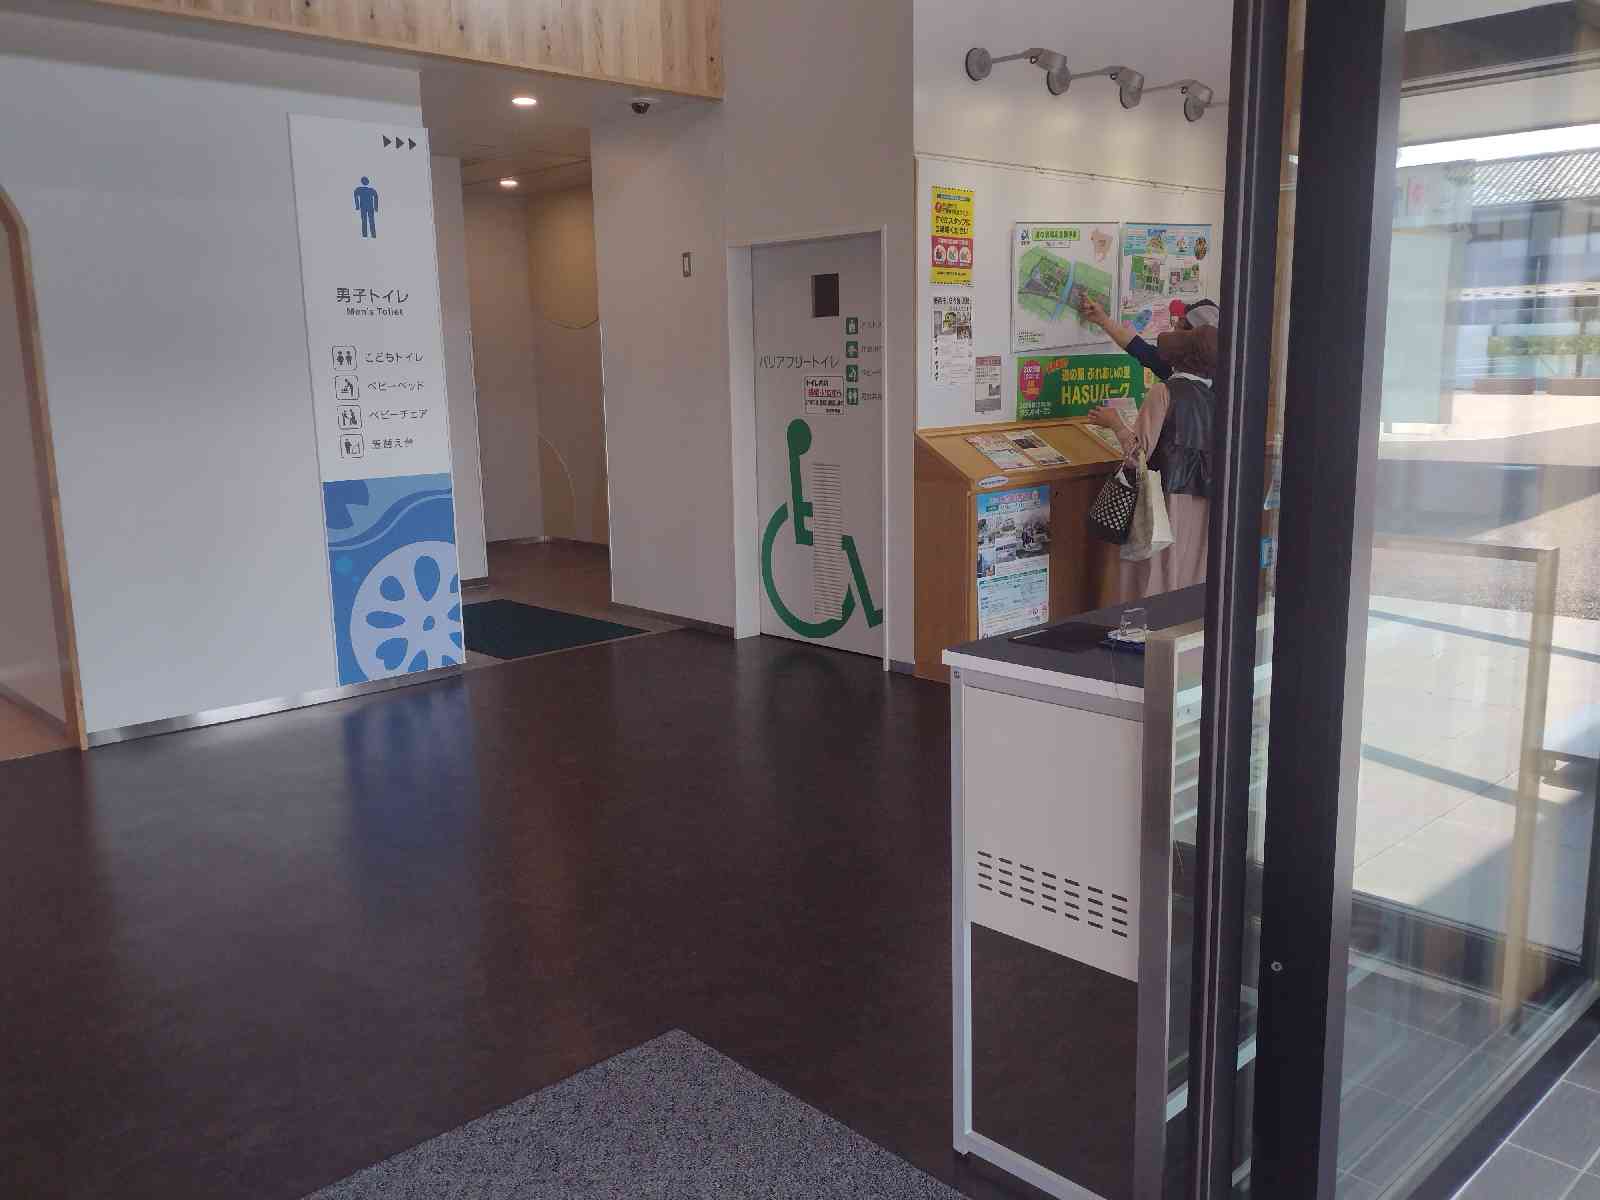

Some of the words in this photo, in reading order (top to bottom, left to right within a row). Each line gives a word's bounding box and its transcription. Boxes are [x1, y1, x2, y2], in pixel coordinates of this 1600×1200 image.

[336, 287, 409, 304] 男子トイレ
[759, 354, 839, 369] バリアフリートイレ
[367, 379, 425, 391] ベビーベッド
[369, 408, 429, 420] ベビーチェア
